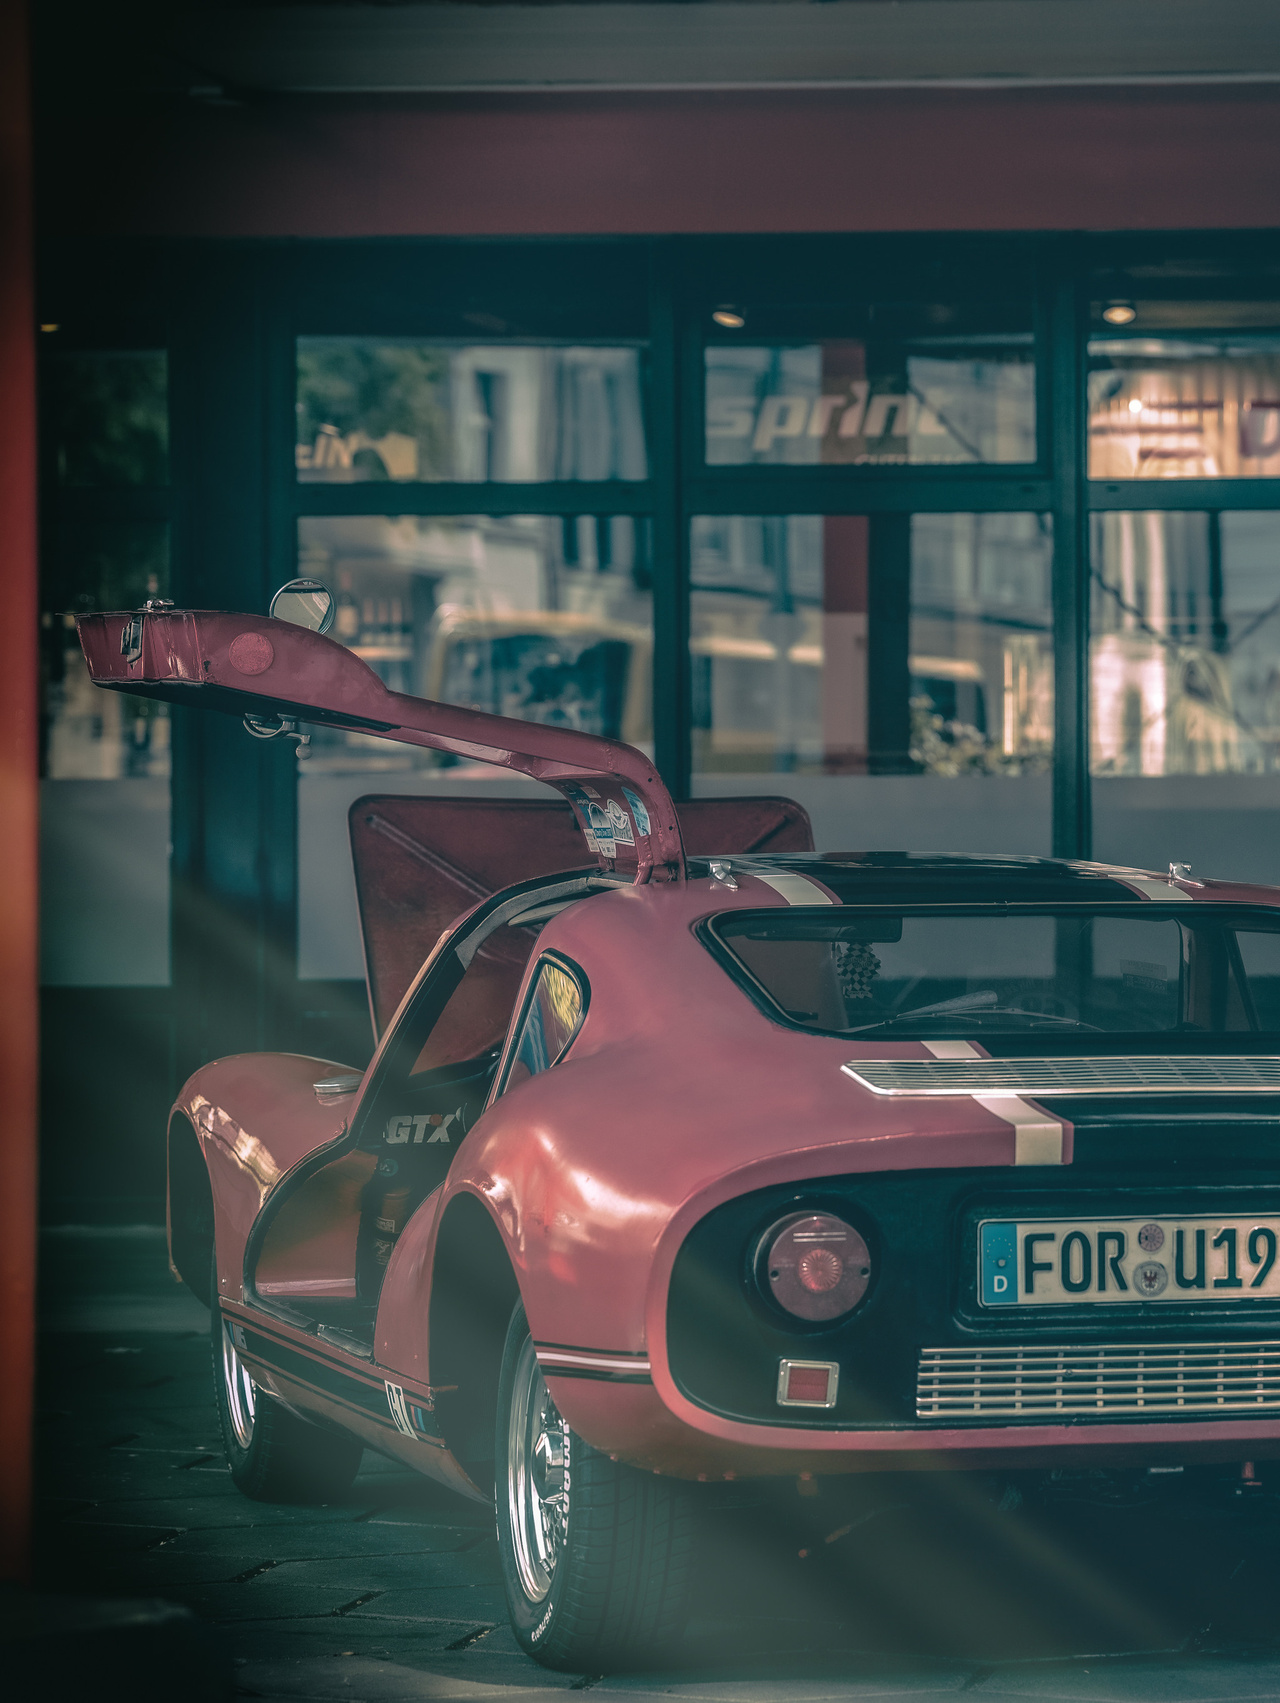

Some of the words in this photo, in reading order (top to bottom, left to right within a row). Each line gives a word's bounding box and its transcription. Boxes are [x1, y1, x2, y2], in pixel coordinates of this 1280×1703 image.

[385, 1114, 456, 1144] GTX
[1024, 1230, 1129, 1294] FOR
[1173, 1226, 1278, 1289] U19
[993, 1275, 1009, 1294] D
